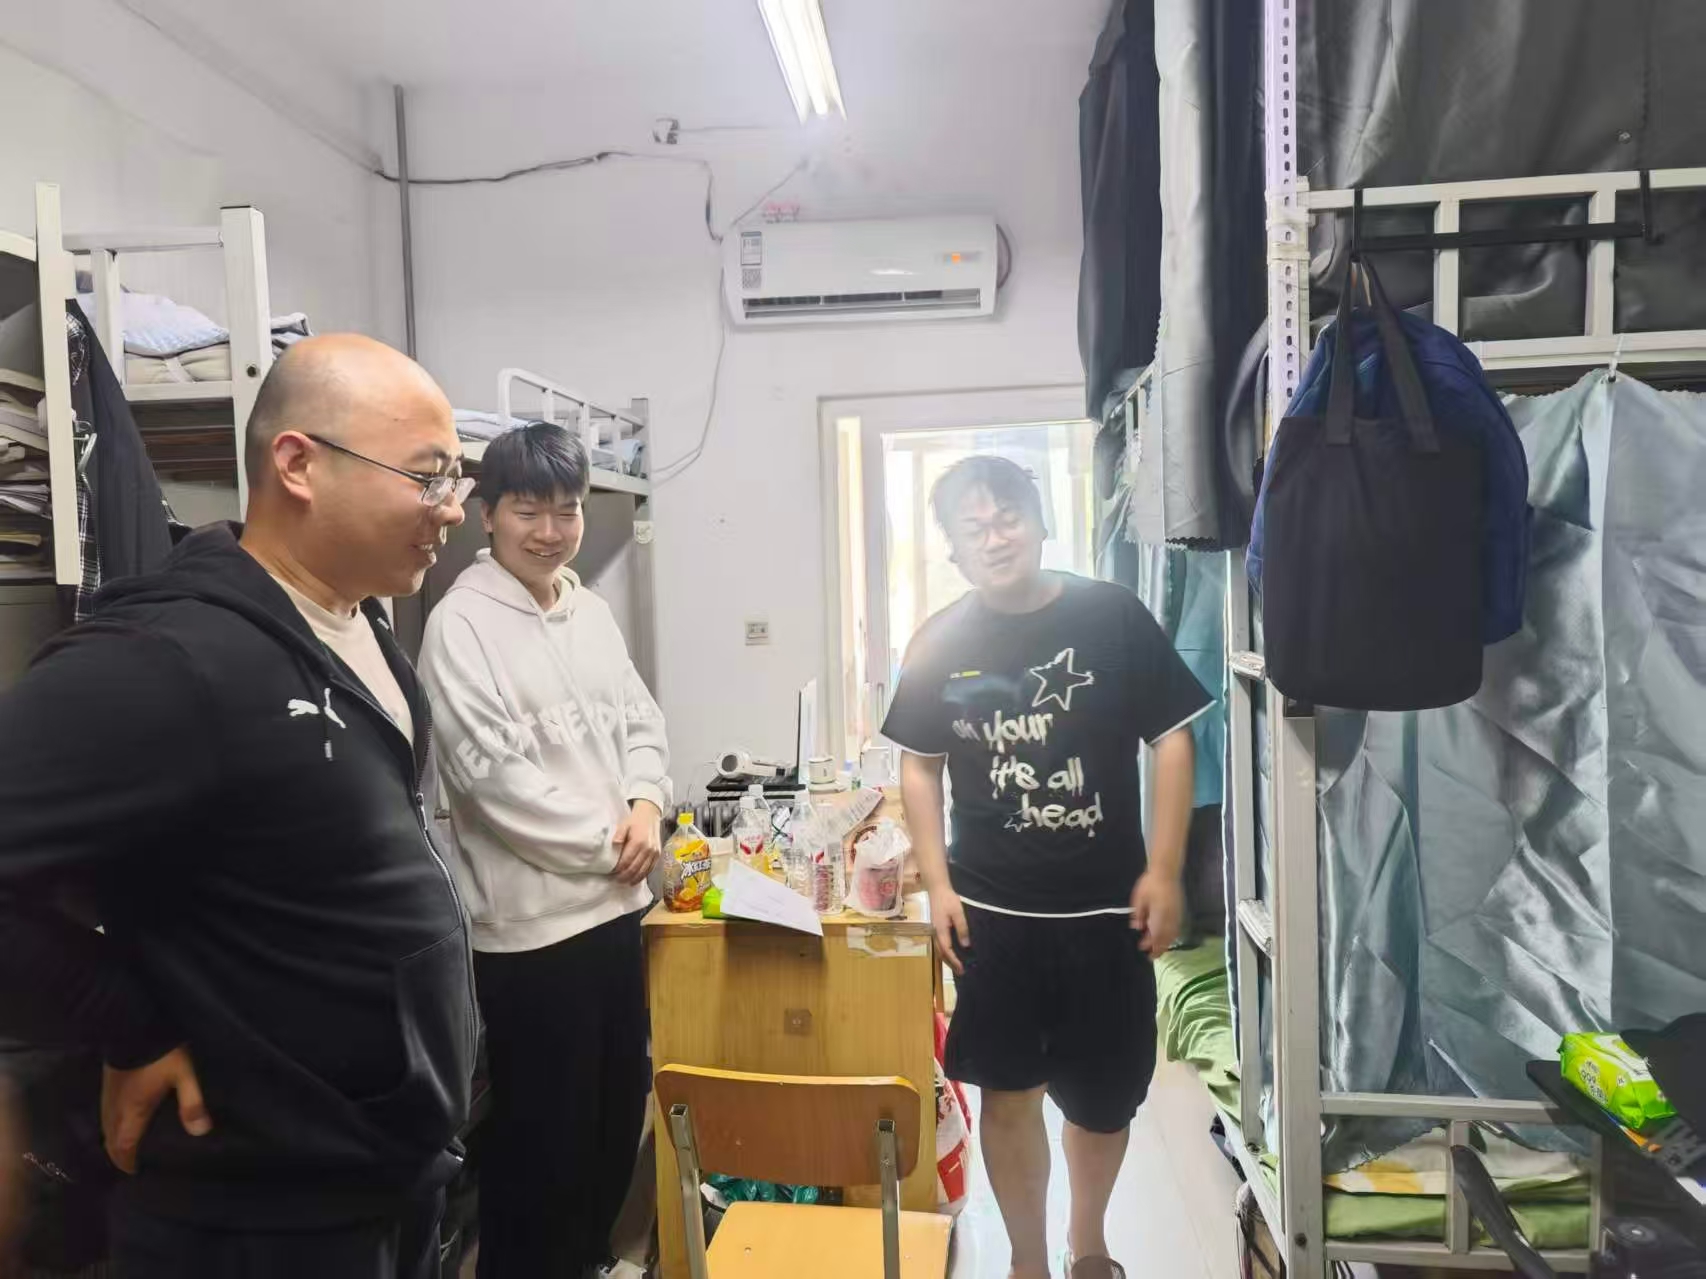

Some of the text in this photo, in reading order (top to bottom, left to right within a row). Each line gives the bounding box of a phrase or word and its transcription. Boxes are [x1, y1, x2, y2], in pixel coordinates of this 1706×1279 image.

[982, 709, 1054, 753] your
[989, 755, 1084, 800] it's all
[1021, 791, 1104, 838] head
